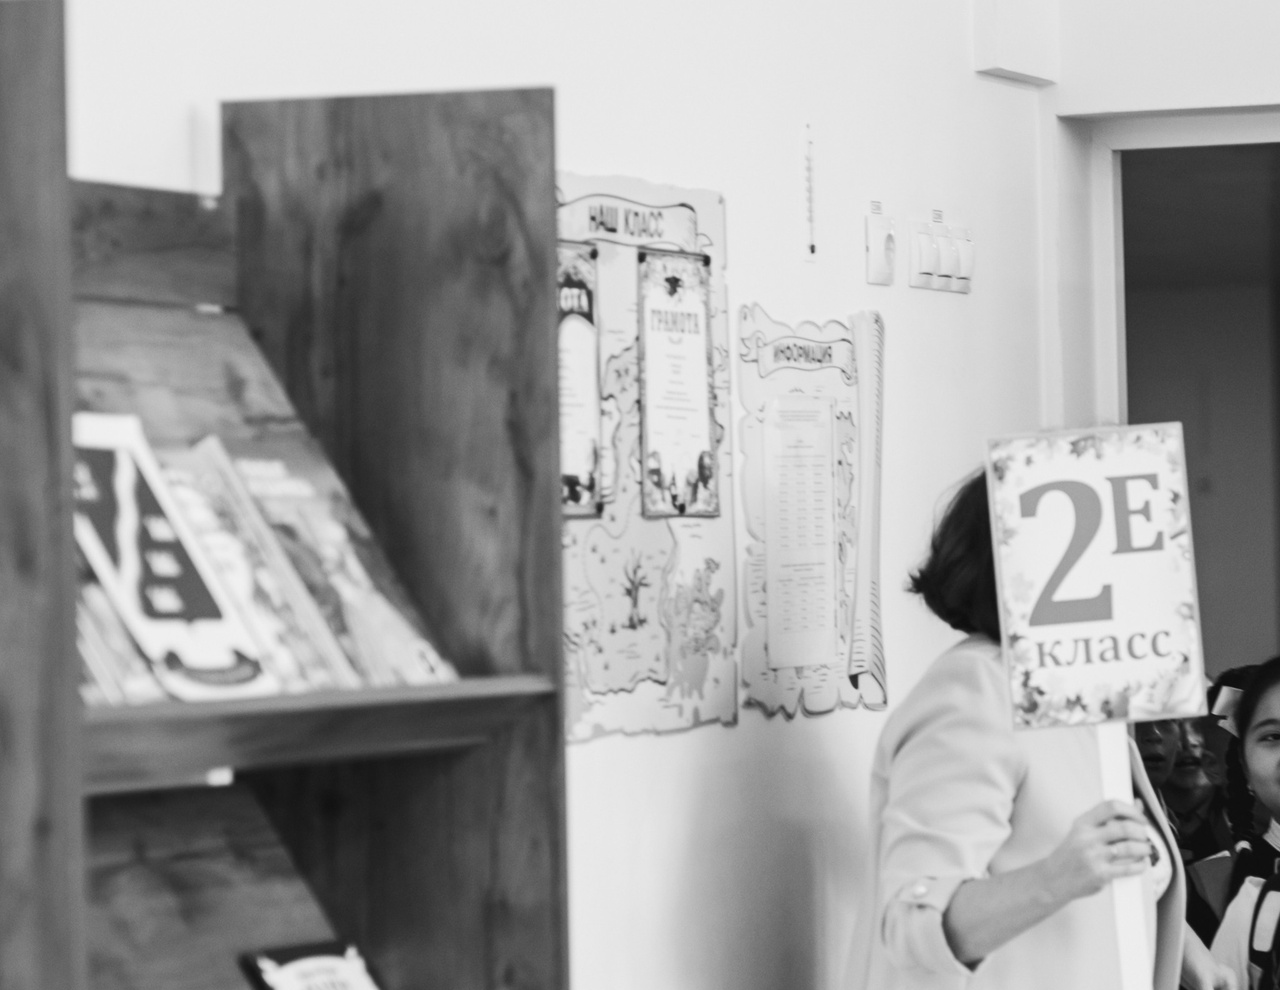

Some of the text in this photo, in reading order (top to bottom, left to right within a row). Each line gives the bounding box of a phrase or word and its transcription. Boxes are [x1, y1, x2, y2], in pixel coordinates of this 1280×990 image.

[588, 205, 663, 239] НАШ КЛАСС
[1037, 630, 1171, 668] класс
